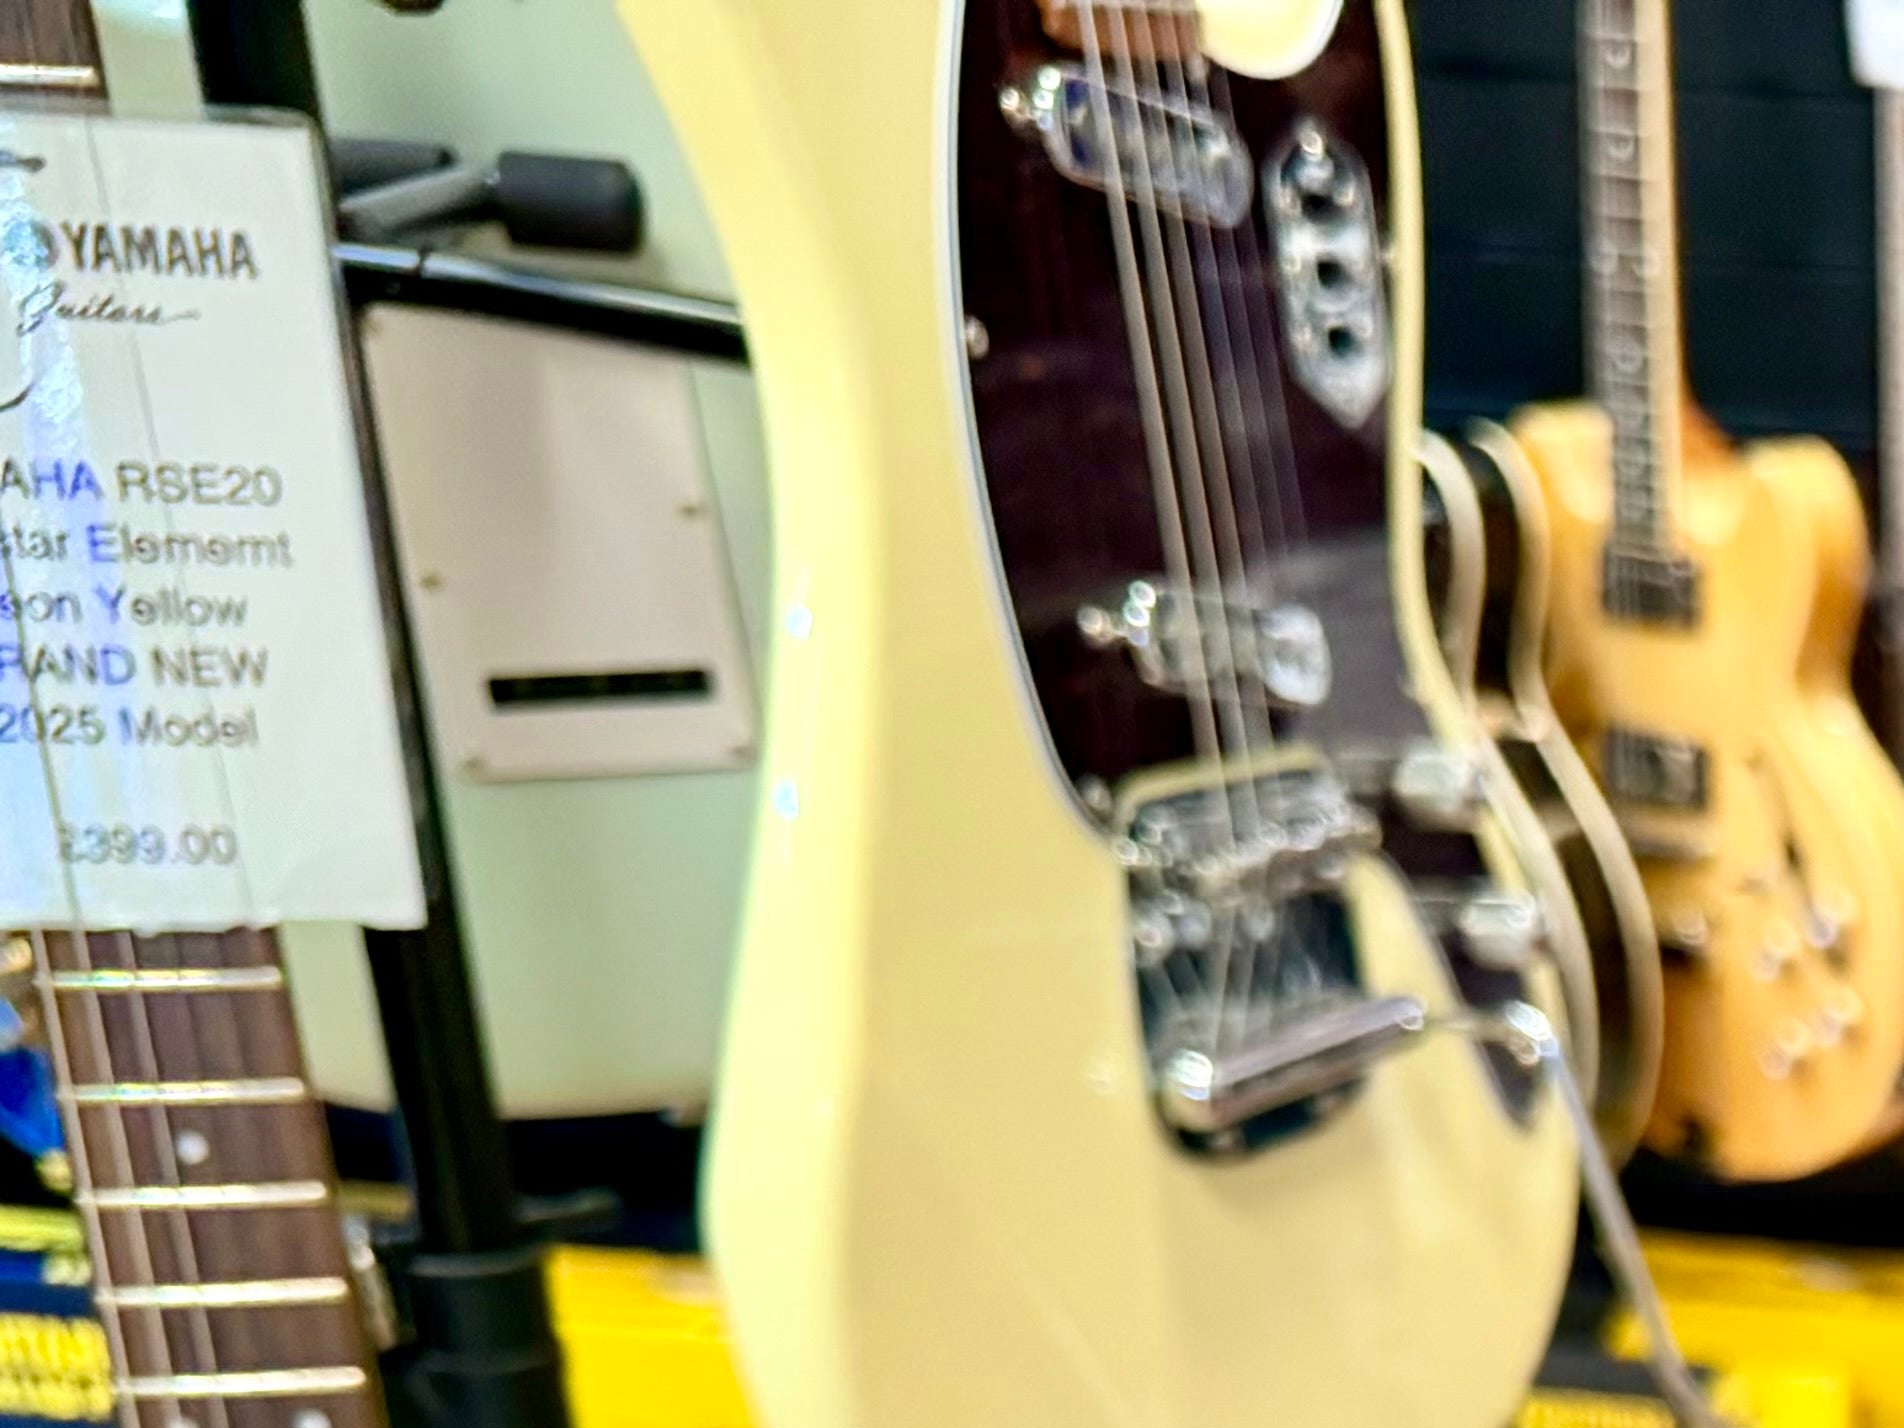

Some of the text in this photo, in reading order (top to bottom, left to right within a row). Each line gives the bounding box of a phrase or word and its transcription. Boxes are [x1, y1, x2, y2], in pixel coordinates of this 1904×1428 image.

[60, 219, 259, 280] YAMAHA
[16, 279, 200, 336] Guitars
[116, 459, 283, 506] RSE20
[94, 583, 248, 627] Yellow
[151, 645, 269, 688] NEW
[0, 701, 260, 748] 2025 Model
